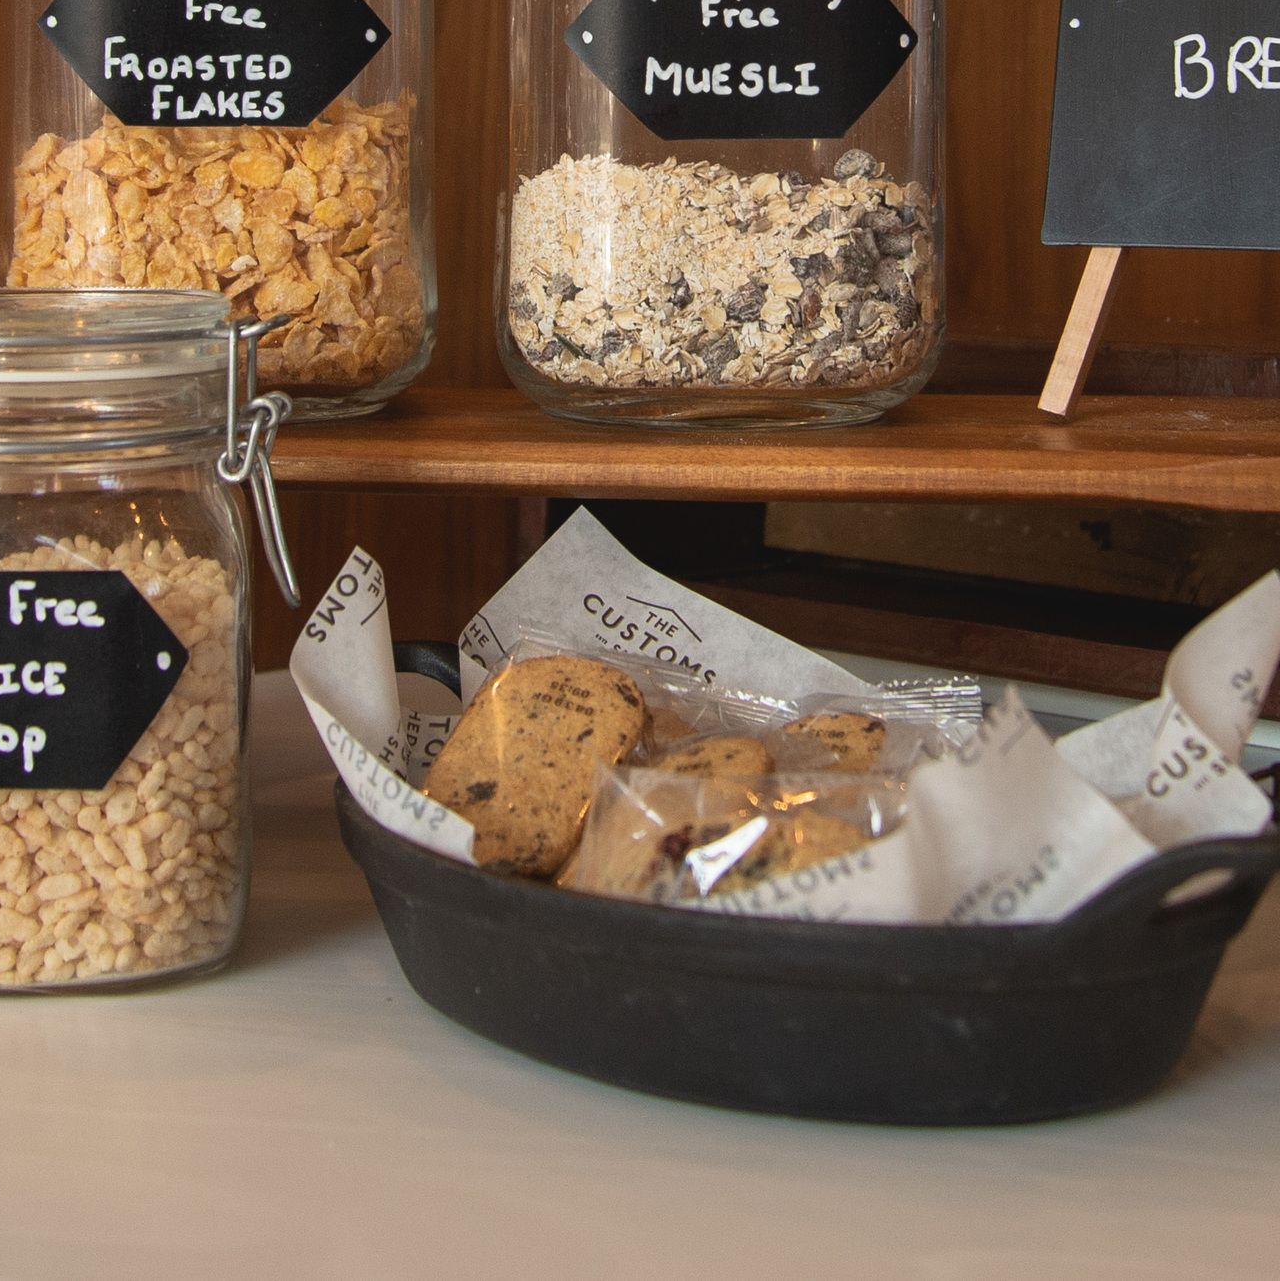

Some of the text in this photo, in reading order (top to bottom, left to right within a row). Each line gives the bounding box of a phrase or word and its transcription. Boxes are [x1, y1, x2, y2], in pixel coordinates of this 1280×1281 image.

[104, 35, 292, 81] FROASTED
[644, 56, 820, 98] MUESLI
[152, 84, 285, 120] FLAKES
[9, 580, 106, 627] Free
[306, 552, 373, 644] TOMS
[583, 593, 717, 686] CUSTOMS
[646, 611, 680, 639] THE
